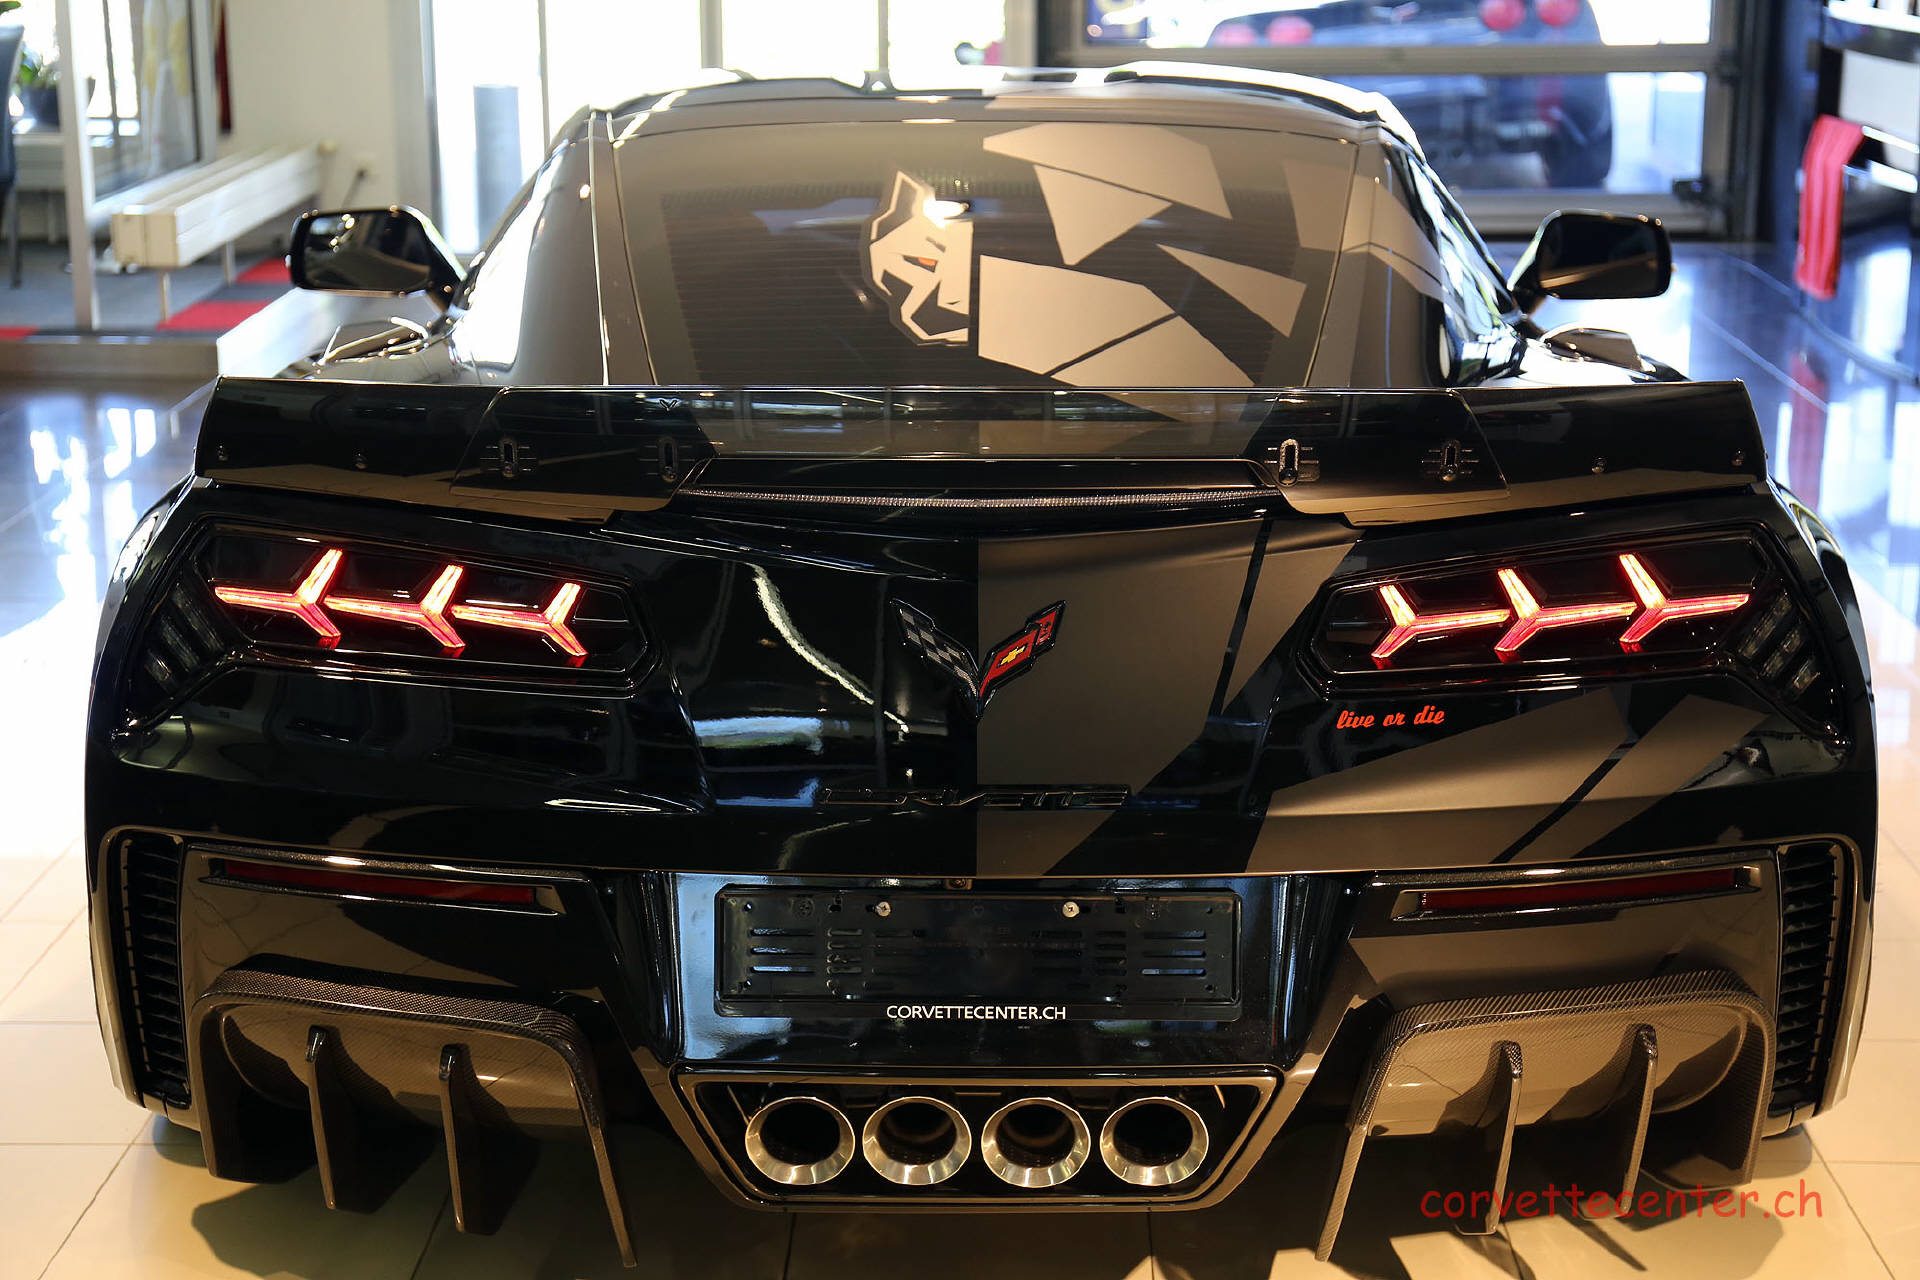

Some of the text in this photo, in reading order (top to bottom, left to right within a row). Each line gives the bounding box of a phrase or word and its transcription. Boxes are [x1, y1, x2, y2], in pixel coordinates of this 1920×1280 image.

[1336, 704, 1445, 729] live or die
[886, 1005, 1067, 1020] CORVETTECENTER.CH
